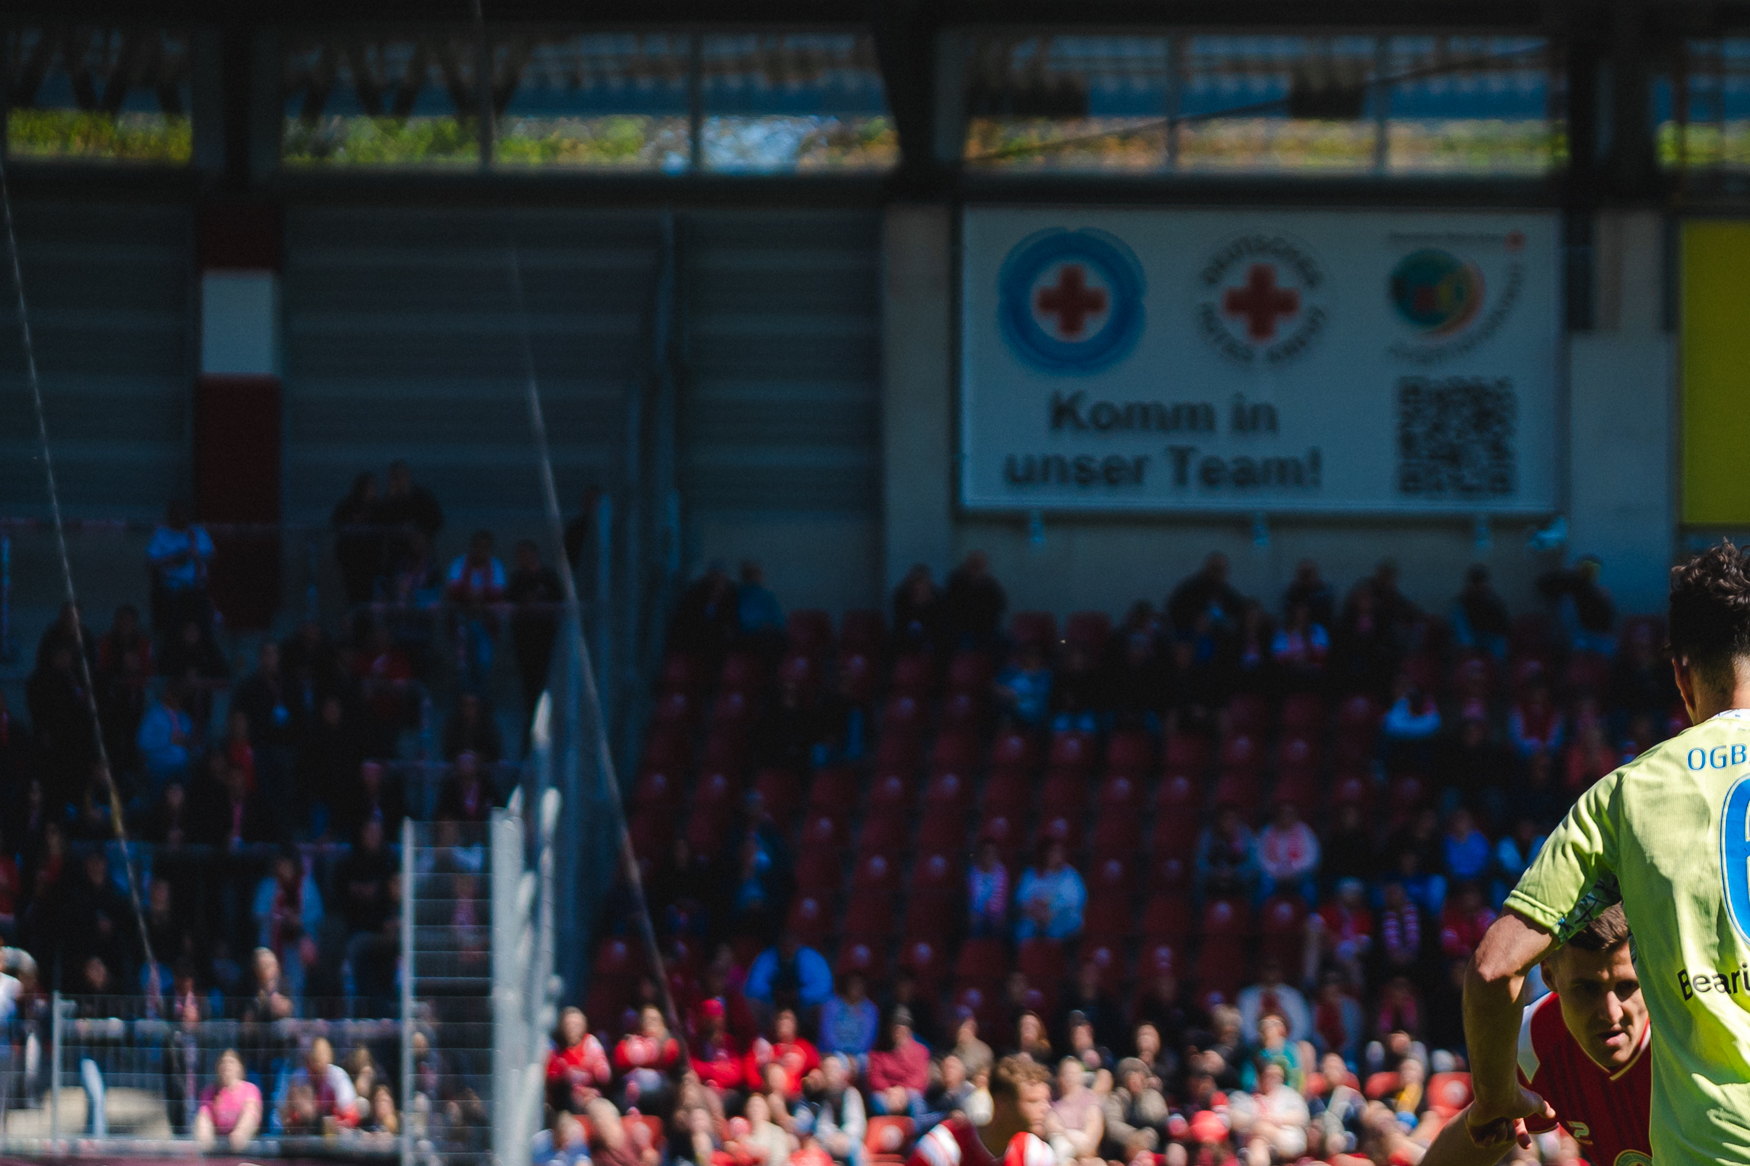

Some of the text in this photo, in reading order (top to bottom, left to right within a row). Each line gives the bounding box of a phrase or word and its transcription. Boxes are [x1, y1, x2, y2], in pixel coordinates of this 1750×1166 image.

[1048, 393, 1278, 433] Komm in
[1006, 447, 1321, 487] unser Team!
